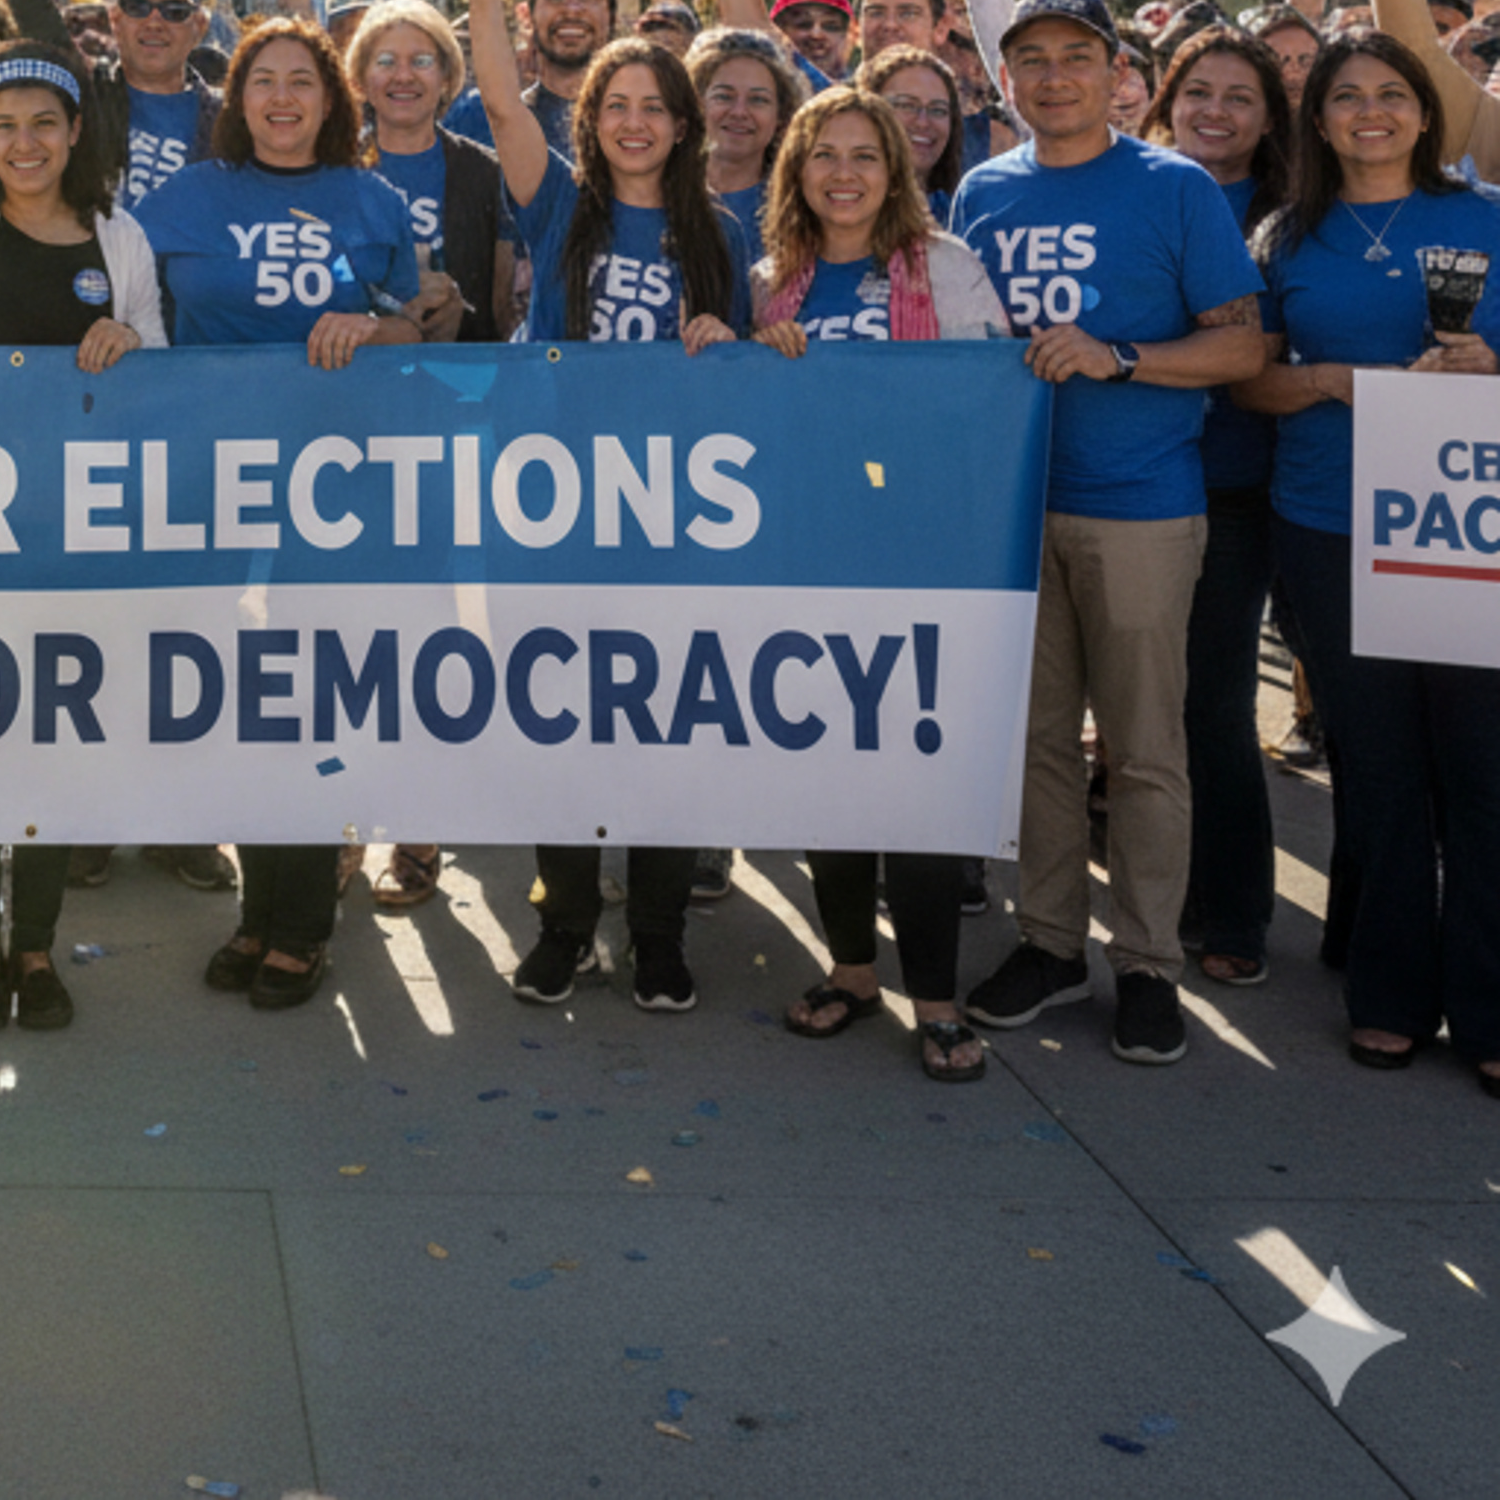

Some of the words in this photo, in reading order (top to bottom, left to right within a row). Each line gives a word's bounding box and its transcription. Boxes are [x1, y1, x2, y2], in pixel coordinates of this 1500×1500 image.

[227, 221, 333, 259] YES
[994, 223, 1097, 273] YES
[255, 261, 334, 307] 50
[1007, 275, 1083, 325] 50
[62, 432, 764, 554] ELECTIONS
[1373, 488, 1500, 555] PAC
[147, 622, 943, 757] DEMOCRACY!
